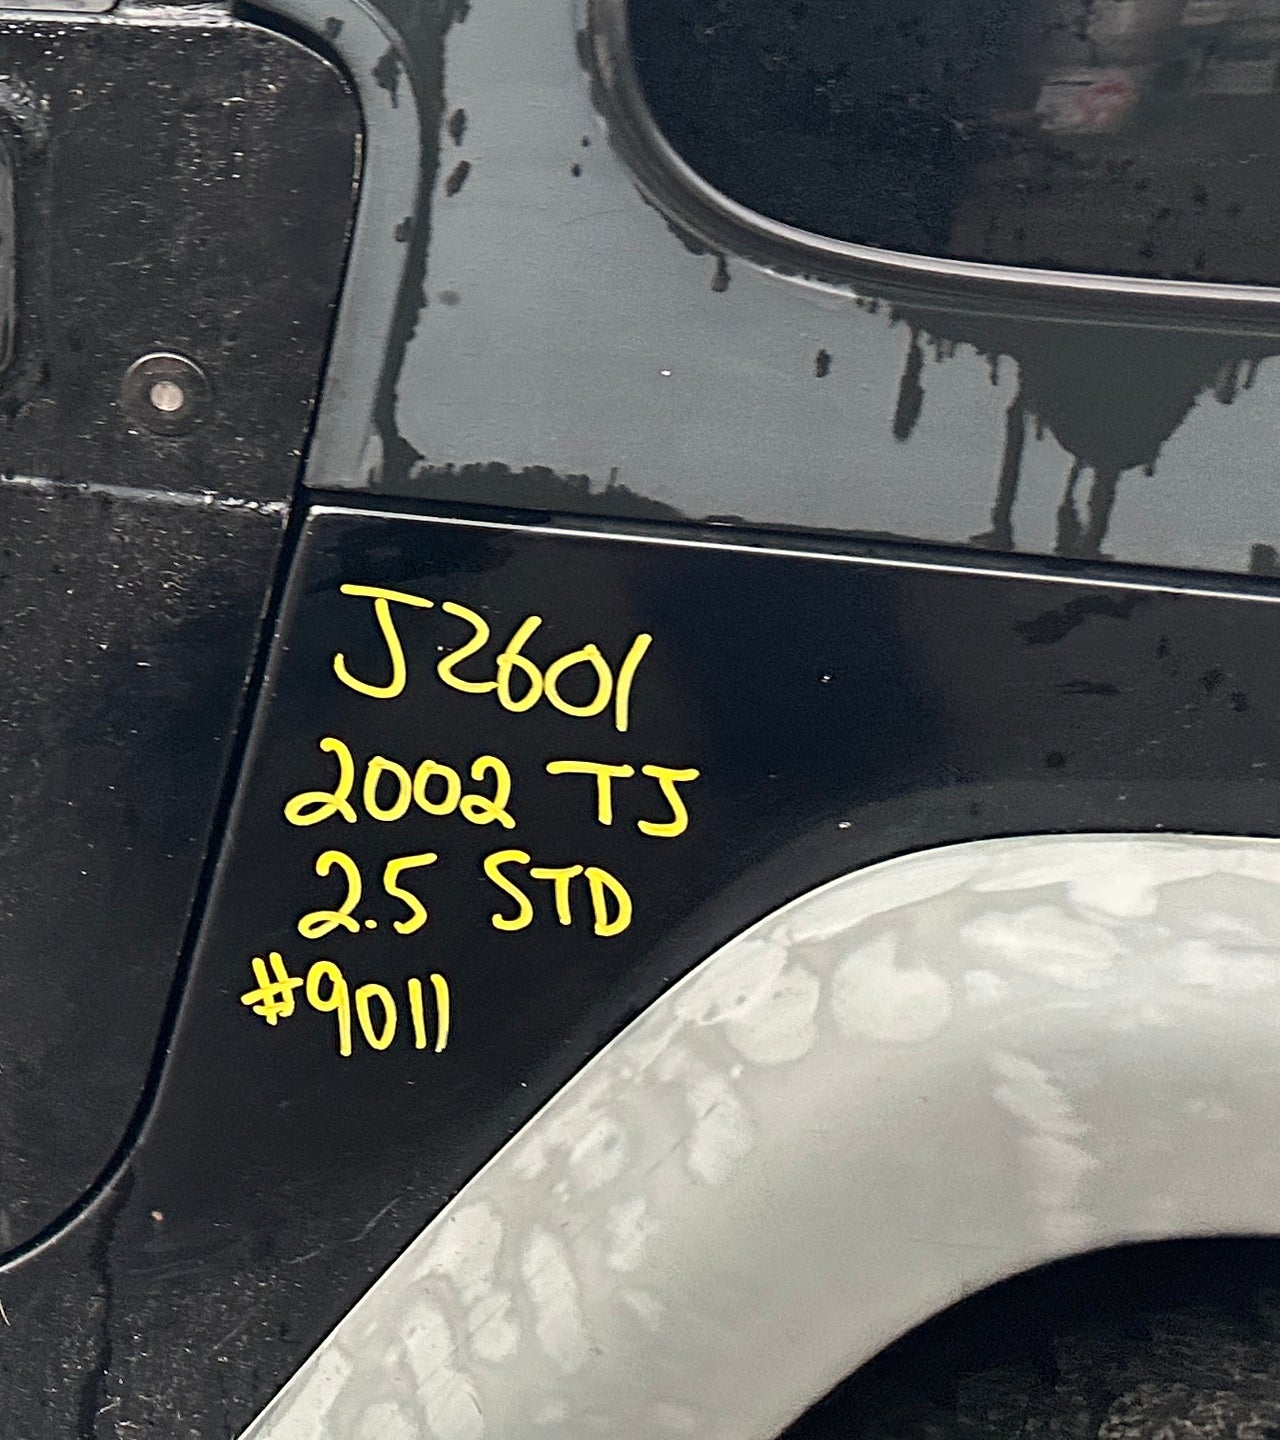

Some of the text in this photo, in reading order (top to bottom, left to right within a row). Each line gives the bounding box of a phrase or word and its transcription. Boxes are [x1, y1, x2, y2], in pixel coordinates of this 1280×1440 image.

[333, 584, 653, 731] J2601
[284, 737, 700, 838] 2002 TJ
[297, 849, 634, 939] 2.5 STD
[240, 952, 452, 1056] #9011
